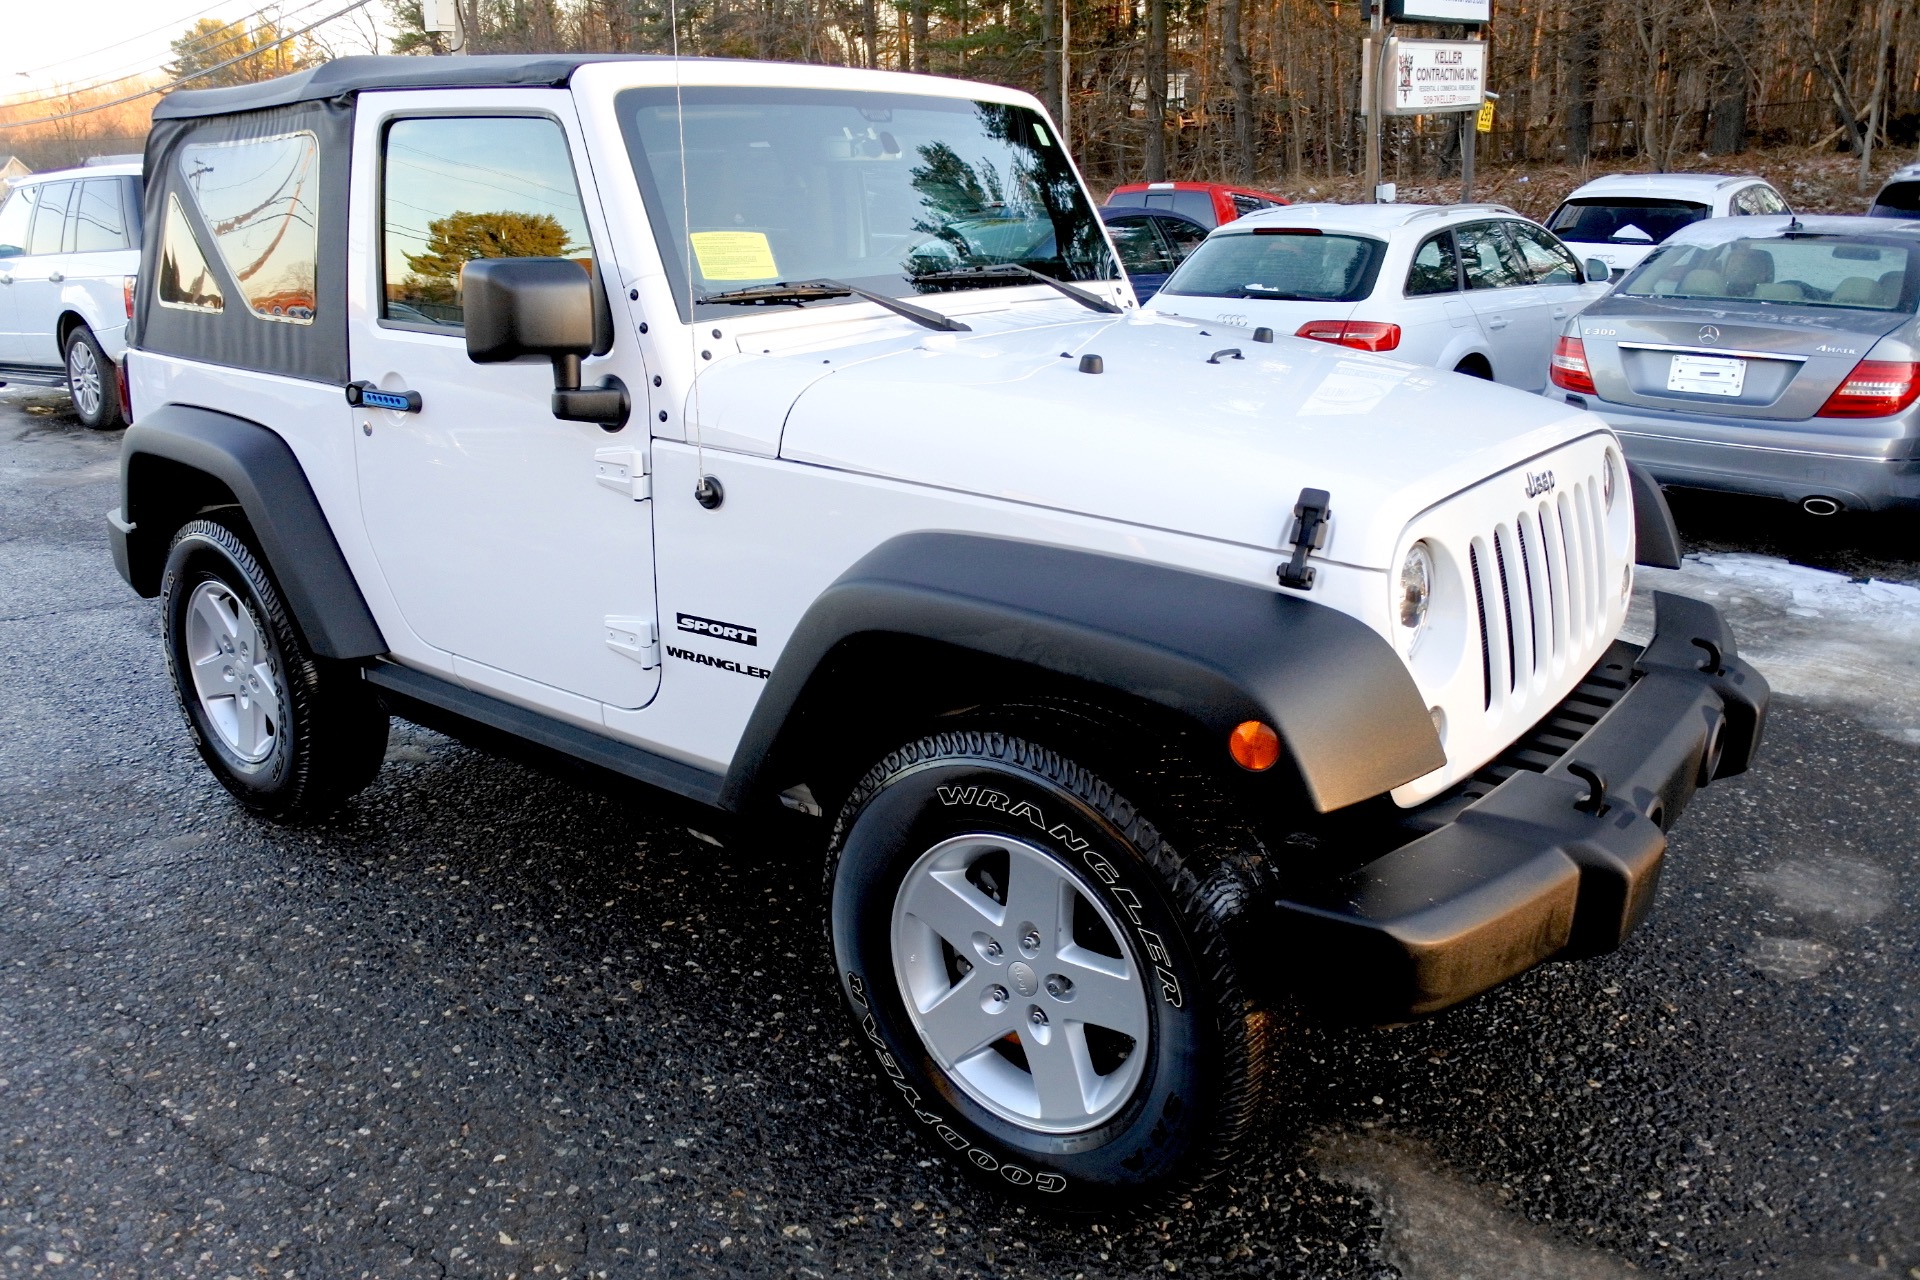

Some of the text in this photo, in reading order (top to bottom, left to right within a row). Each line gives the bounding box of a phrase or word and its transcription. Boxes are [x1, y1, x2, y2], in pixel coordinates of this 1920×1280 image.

[1435, 51, 1462, 65] KELLER
[1416, 68, 1478, 81] CONTRACTING INC.
[1525, 470, 1555, 499] Jeep
[677, 616, 757, 643] SPORT
[666, 645, 771, 680] WRANGLER
[936, 785, 1182, 1009] WRANGLER
[847, 971, 1067, 1193] GOODYEAR
